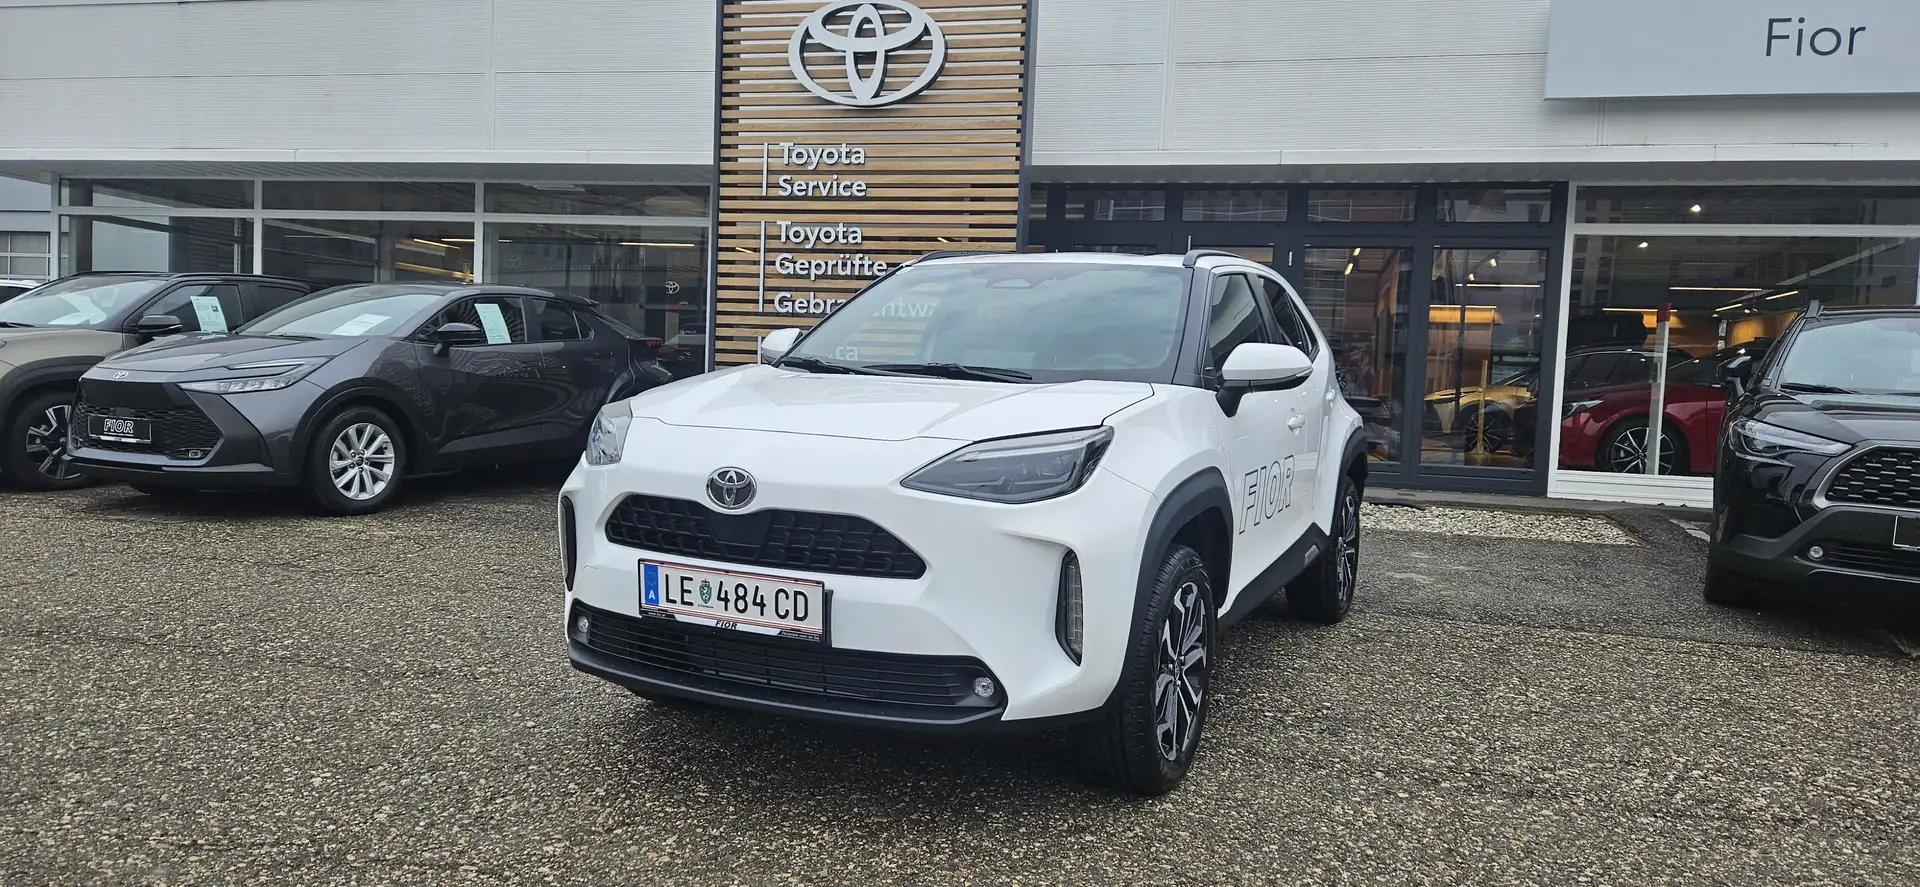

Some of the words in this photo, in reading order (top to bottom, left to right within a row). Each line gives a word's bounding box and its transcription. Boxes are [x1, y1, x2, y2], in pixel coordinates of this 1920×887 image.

[1766, 17, 1866, 56] Fior
[779, 142, 866, 170] Toyota
[778, 175, 867, 197] Service
[776, 220, 863, 248] Toyota
[775, 253, 888, 281] Geprüfte
[104, 418, 134, 433] FIOR
[1239, 454, 1295, 535] FIOR
[648, 590, 656, 600] A
[665, 573, 694, 606] LE
[716, 580, 767, 617] 484
[774, 588, 809, 622] CD
[715, 620, 738, 630] FIOR
